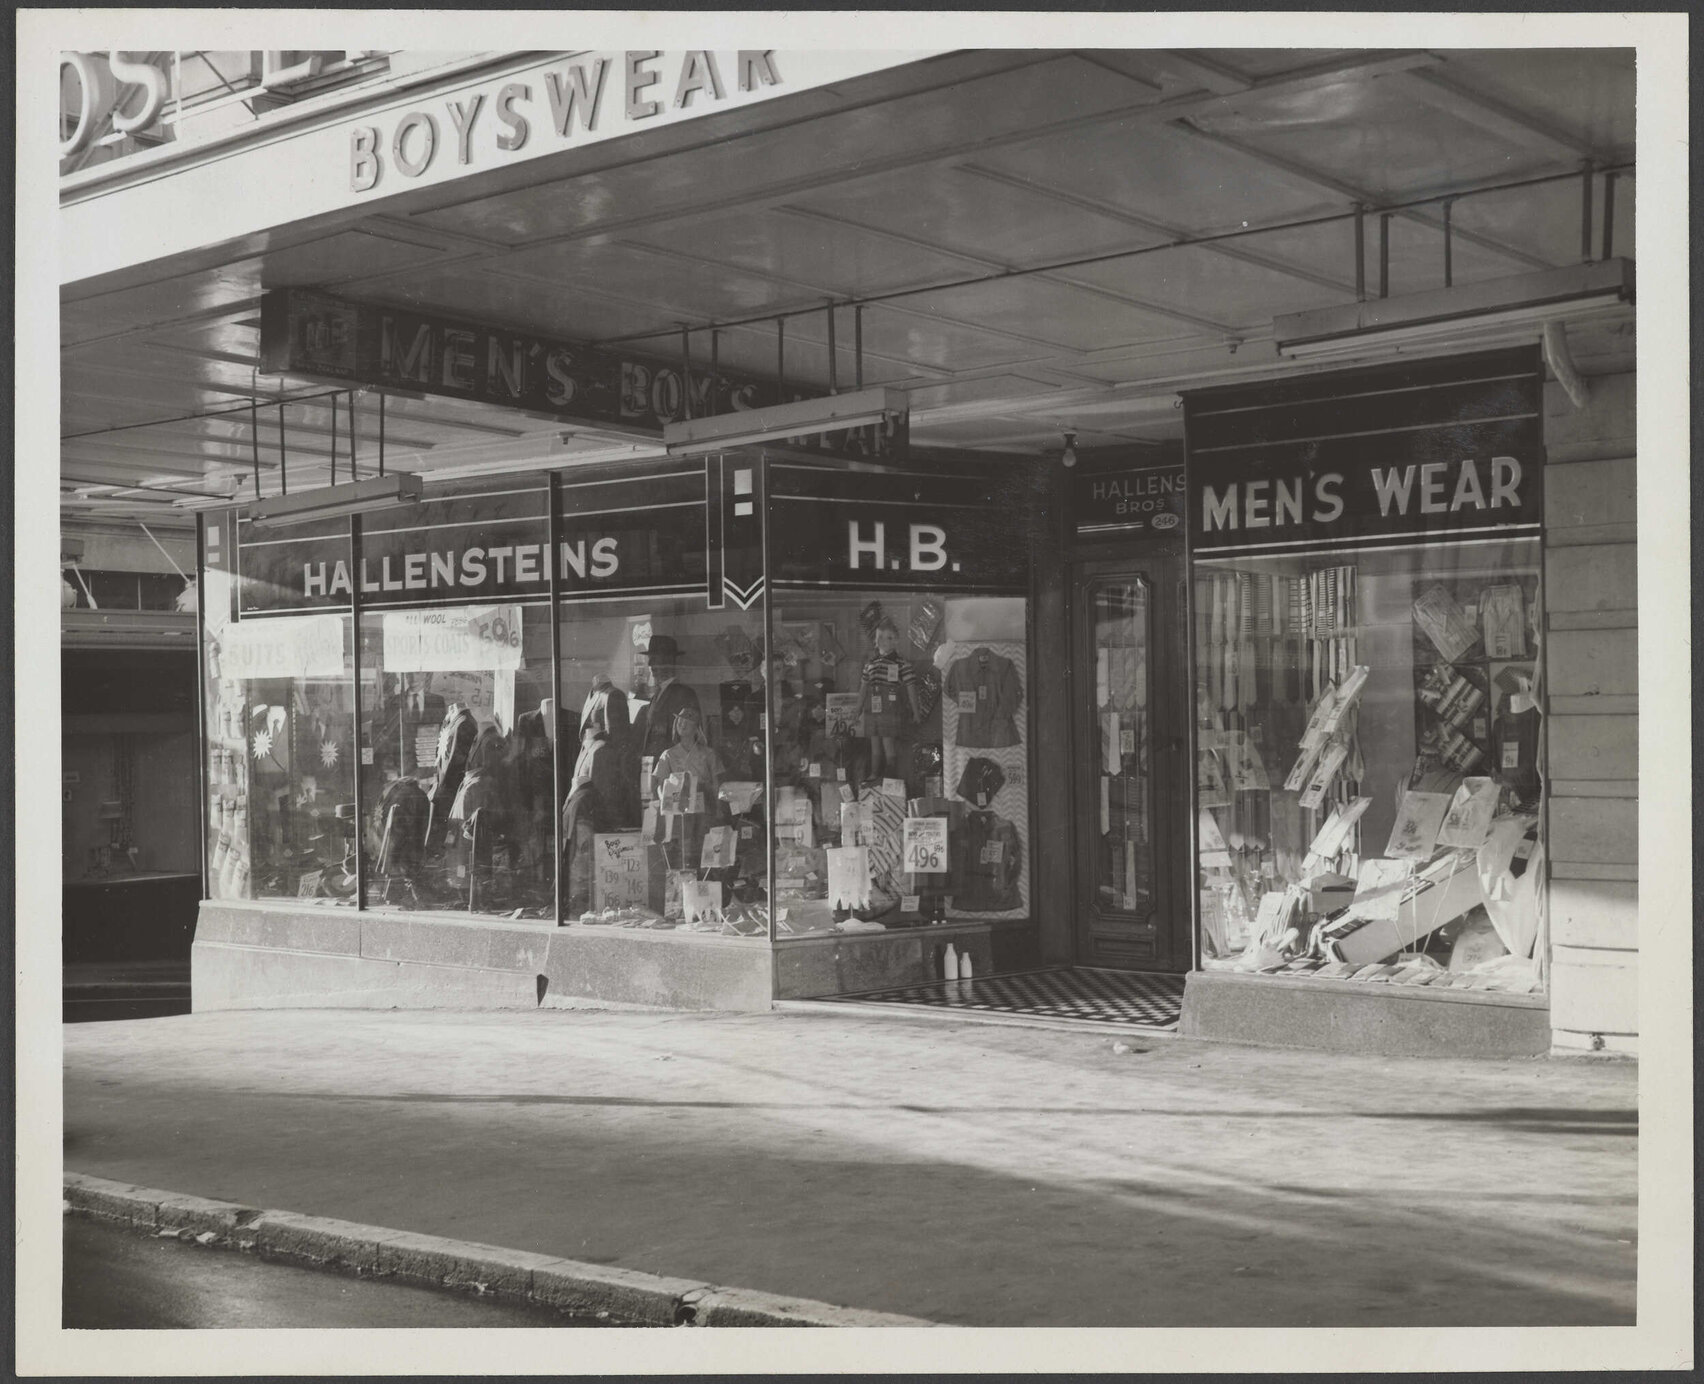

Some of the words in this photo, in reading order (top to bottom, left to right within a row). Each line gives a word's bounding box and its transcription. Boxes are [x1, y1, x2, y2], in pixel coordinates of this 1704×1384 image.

[1203, 472, 1345, 532] MEN'S
[1371, 456, 1522, 517] WEAR
[849, 520, 960, 571] H.B.
[1155, 516, 1175, 526] 246
[304, 537, 619, 598] HALLENSTEINS
[423, 614, 446, 624] WOOL
